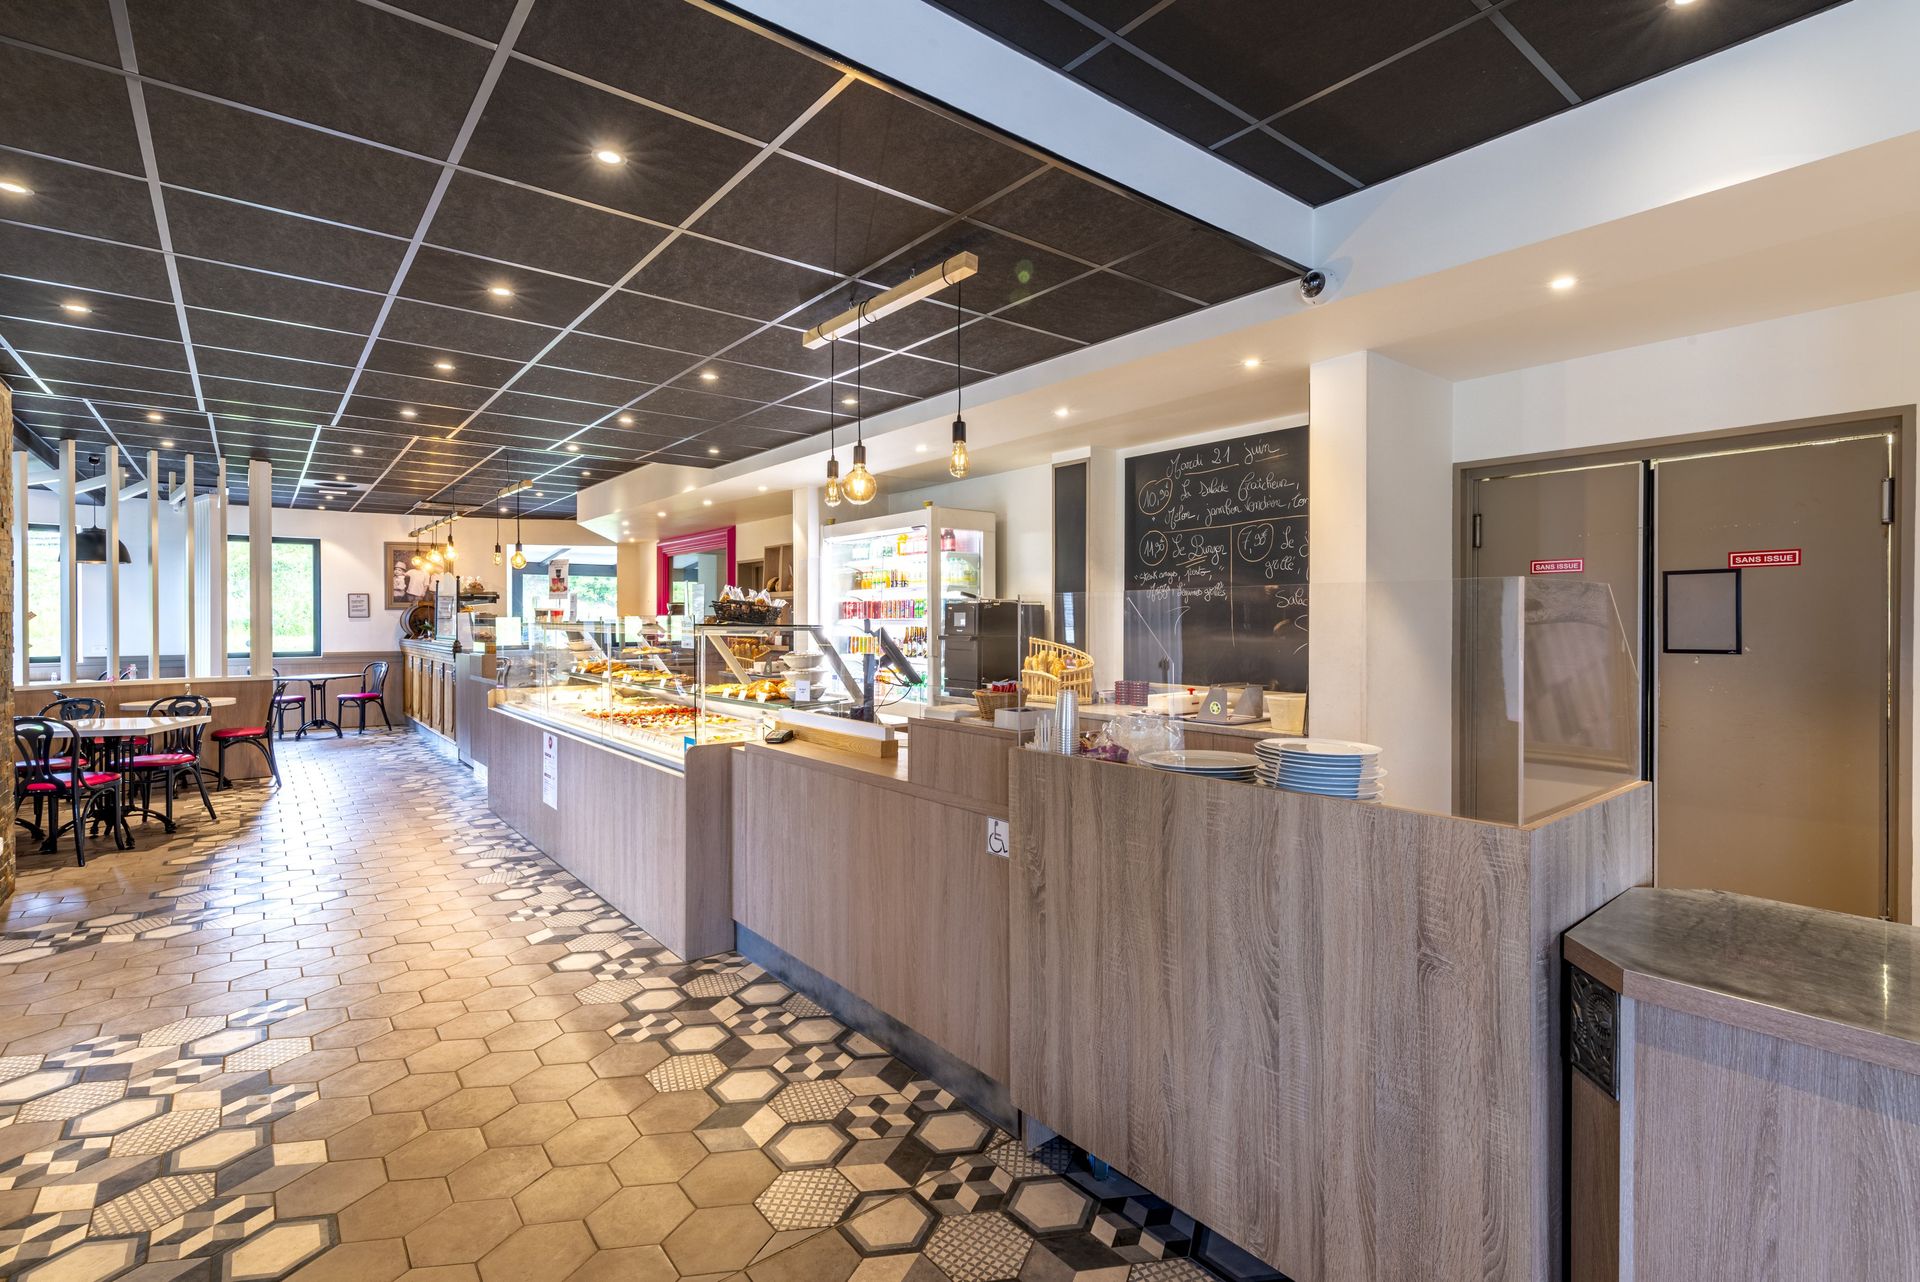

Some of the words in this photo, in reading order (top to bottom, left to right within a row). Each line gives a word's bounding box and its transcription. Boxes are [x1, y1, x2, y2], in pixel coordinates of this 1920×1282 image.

[1166, 452, 1203, 479] Mardi
[1211, 446, 1230, 464] 21
[1243, 439, 1281, 465] juin
[1172, 533, 1186, 558] Le
[1188, 534, 1228, 565] Burger
[1280, 526, 1295, 550] Le
[1556, 562, 1579, 570] ISSUE
[1735, 556, 1761, 564] SANS
[1764, 554, 1793, 562] ISSUE
